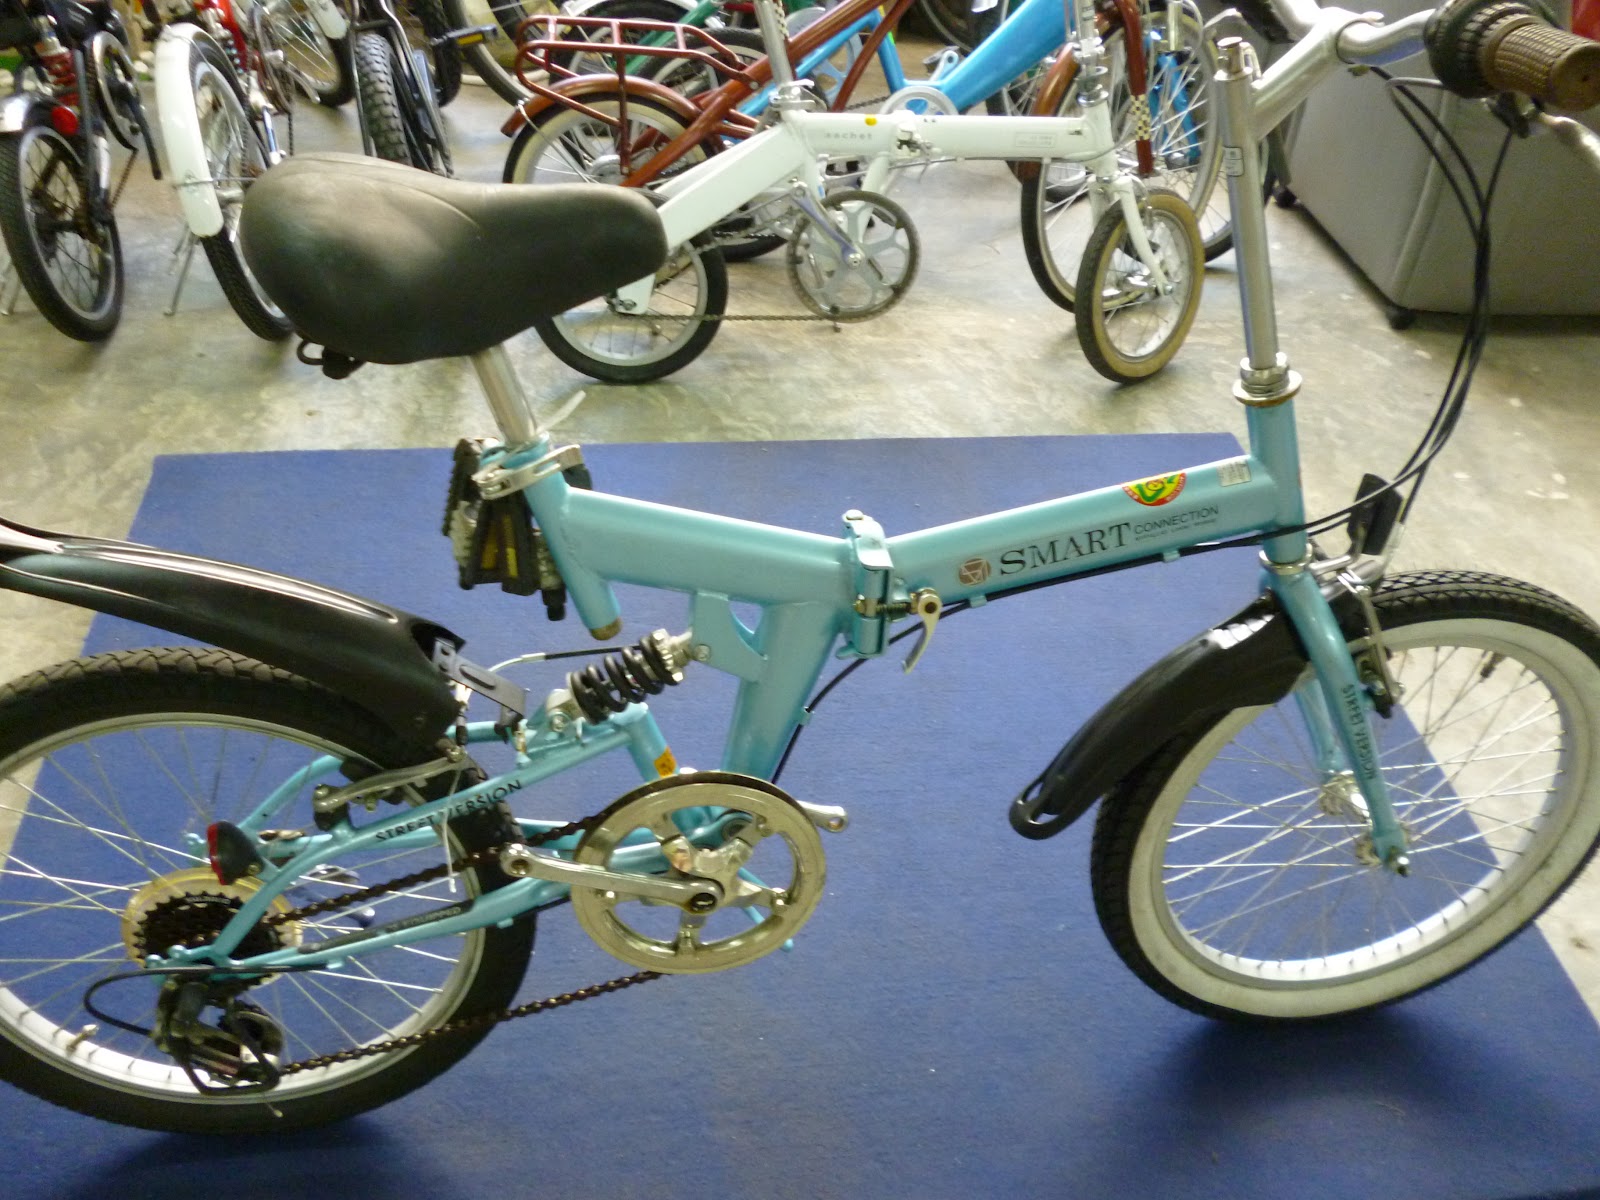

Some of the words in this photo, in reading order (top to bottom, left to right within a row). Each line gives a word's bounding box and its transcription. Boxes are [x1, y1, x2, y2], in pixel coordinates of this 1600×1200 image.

[1000, 521, 1131, 576] SMART
[1134, 504, 1219, 534] CONNECTION
[1342, 683, 1365, 726] STREET
[375, 814, 436, 842] STREET
